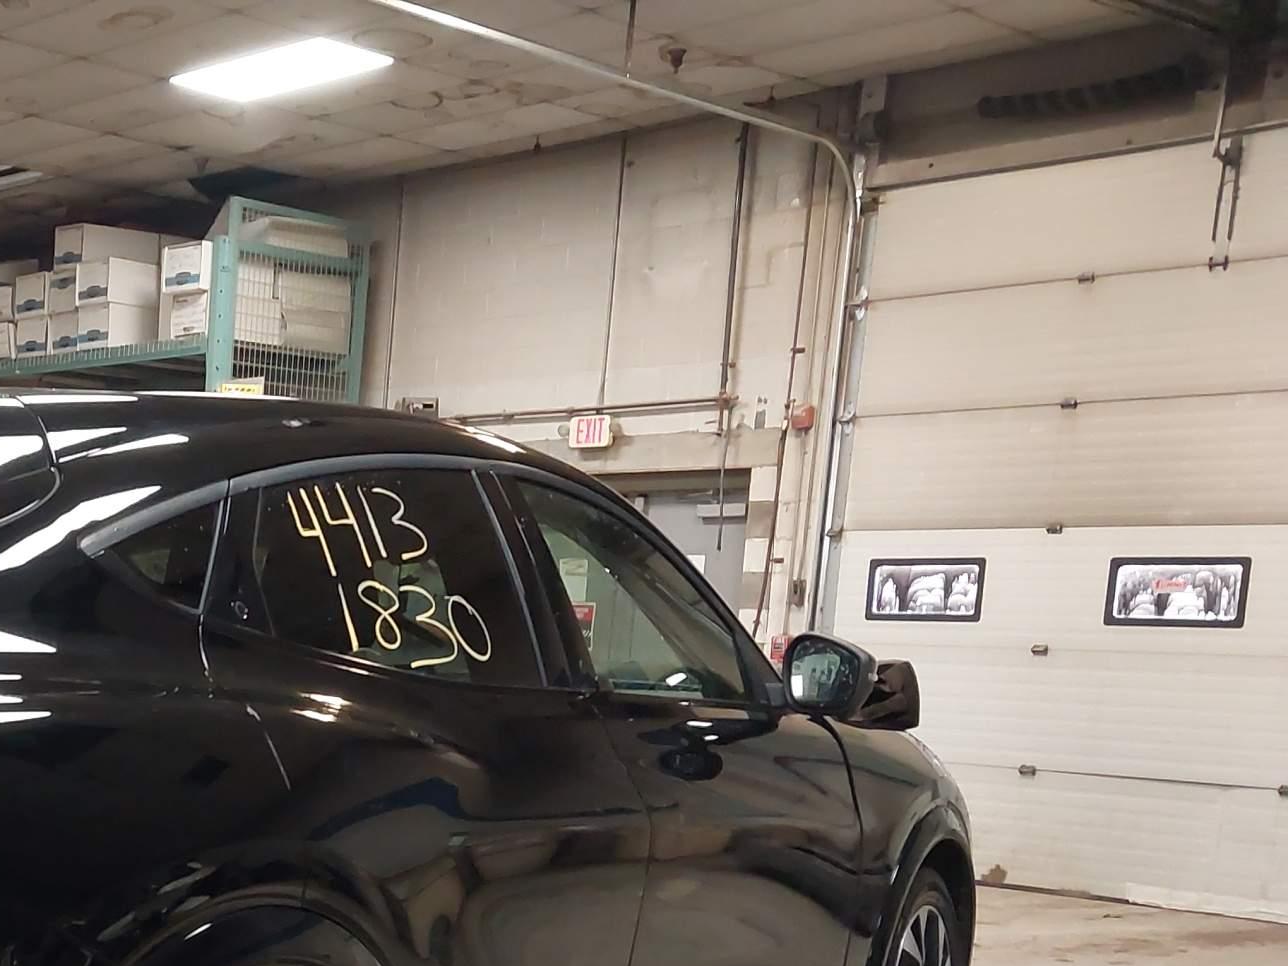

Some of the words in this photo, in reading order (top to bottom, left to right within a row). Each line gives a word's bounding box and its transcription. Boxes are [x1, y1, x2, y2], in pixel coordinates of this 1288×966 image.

[575, 417, 605, 444] EXIT
[287, 481, 428, 577] 4413
[337, 579, 492, 669] 1830
